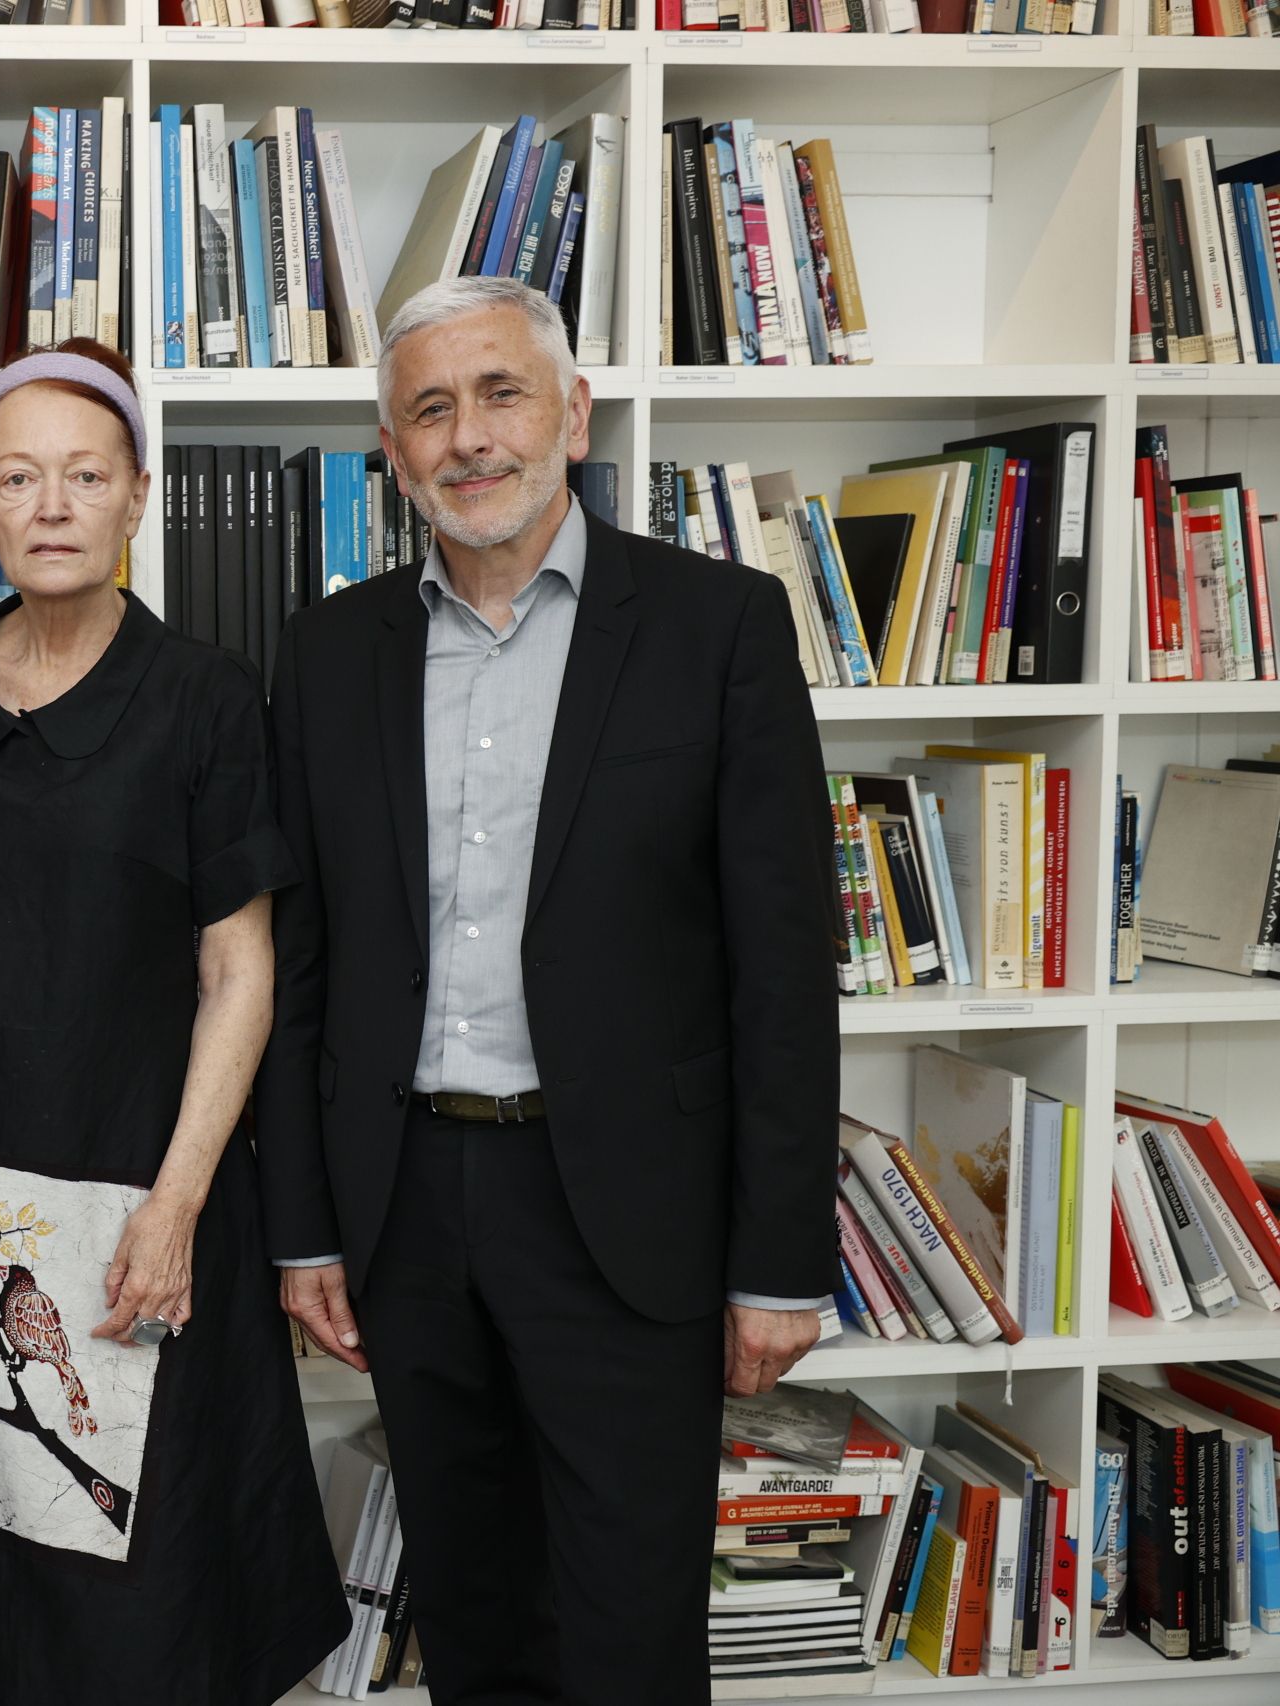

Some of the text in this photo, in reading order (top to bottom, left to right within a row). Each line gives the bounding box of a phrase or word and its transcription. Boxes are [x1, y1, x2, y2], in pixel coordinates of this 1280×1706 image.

[80, 120, 96, 222] MAKING CHOICES
[284, 131, 294, 180] HANNOVER
[682, 148, 698, 219] Bali Inspires
[303, 160, 319, 260] Neue Sachlichkeit
[551, 165, 571, 219] ART DECO
[290, 197, 299, 259] SACHLICHKEIT
[294, 262, 302, 286] NEUE
[1131, 236, 1145, 296] Mythos Art
[997, 802, 1009, 844] kunst
[1045, 832, 1054, 928] KONSTRUKTÍV KONKRÉT
[1120, 862, 1132, 927] TOGETHER
[858, 892, 876, 937] malerei
[882, 1167, 942, 1253] NACH 1970
[893, 1146, 947, 1224] Industrieviertel
[1144, 1136, 1160, 1163] MADE
[1157, 1164, 1166, 1177] IN
[1163, 1177, 1190, 1227] GERMANY
[1200, 1177, 1217, 1201] Made
[1214, 1201, 1223, 1213] in
[1220, 1212, 1245, 1251] Germany
[1243, 1248, 1259, 1270] Drei
[888, 1245, 911, 1275] NEUE
[759, 1479, 833, 1493] AVANTGARDE!
[1236, 1485, 1245, 1537] STANDARD
[985, 1500, 994, 1535] Primary
[1170, 1506, 1189, 1555] out
[1236, 1540, 1245, 1563] TIME
